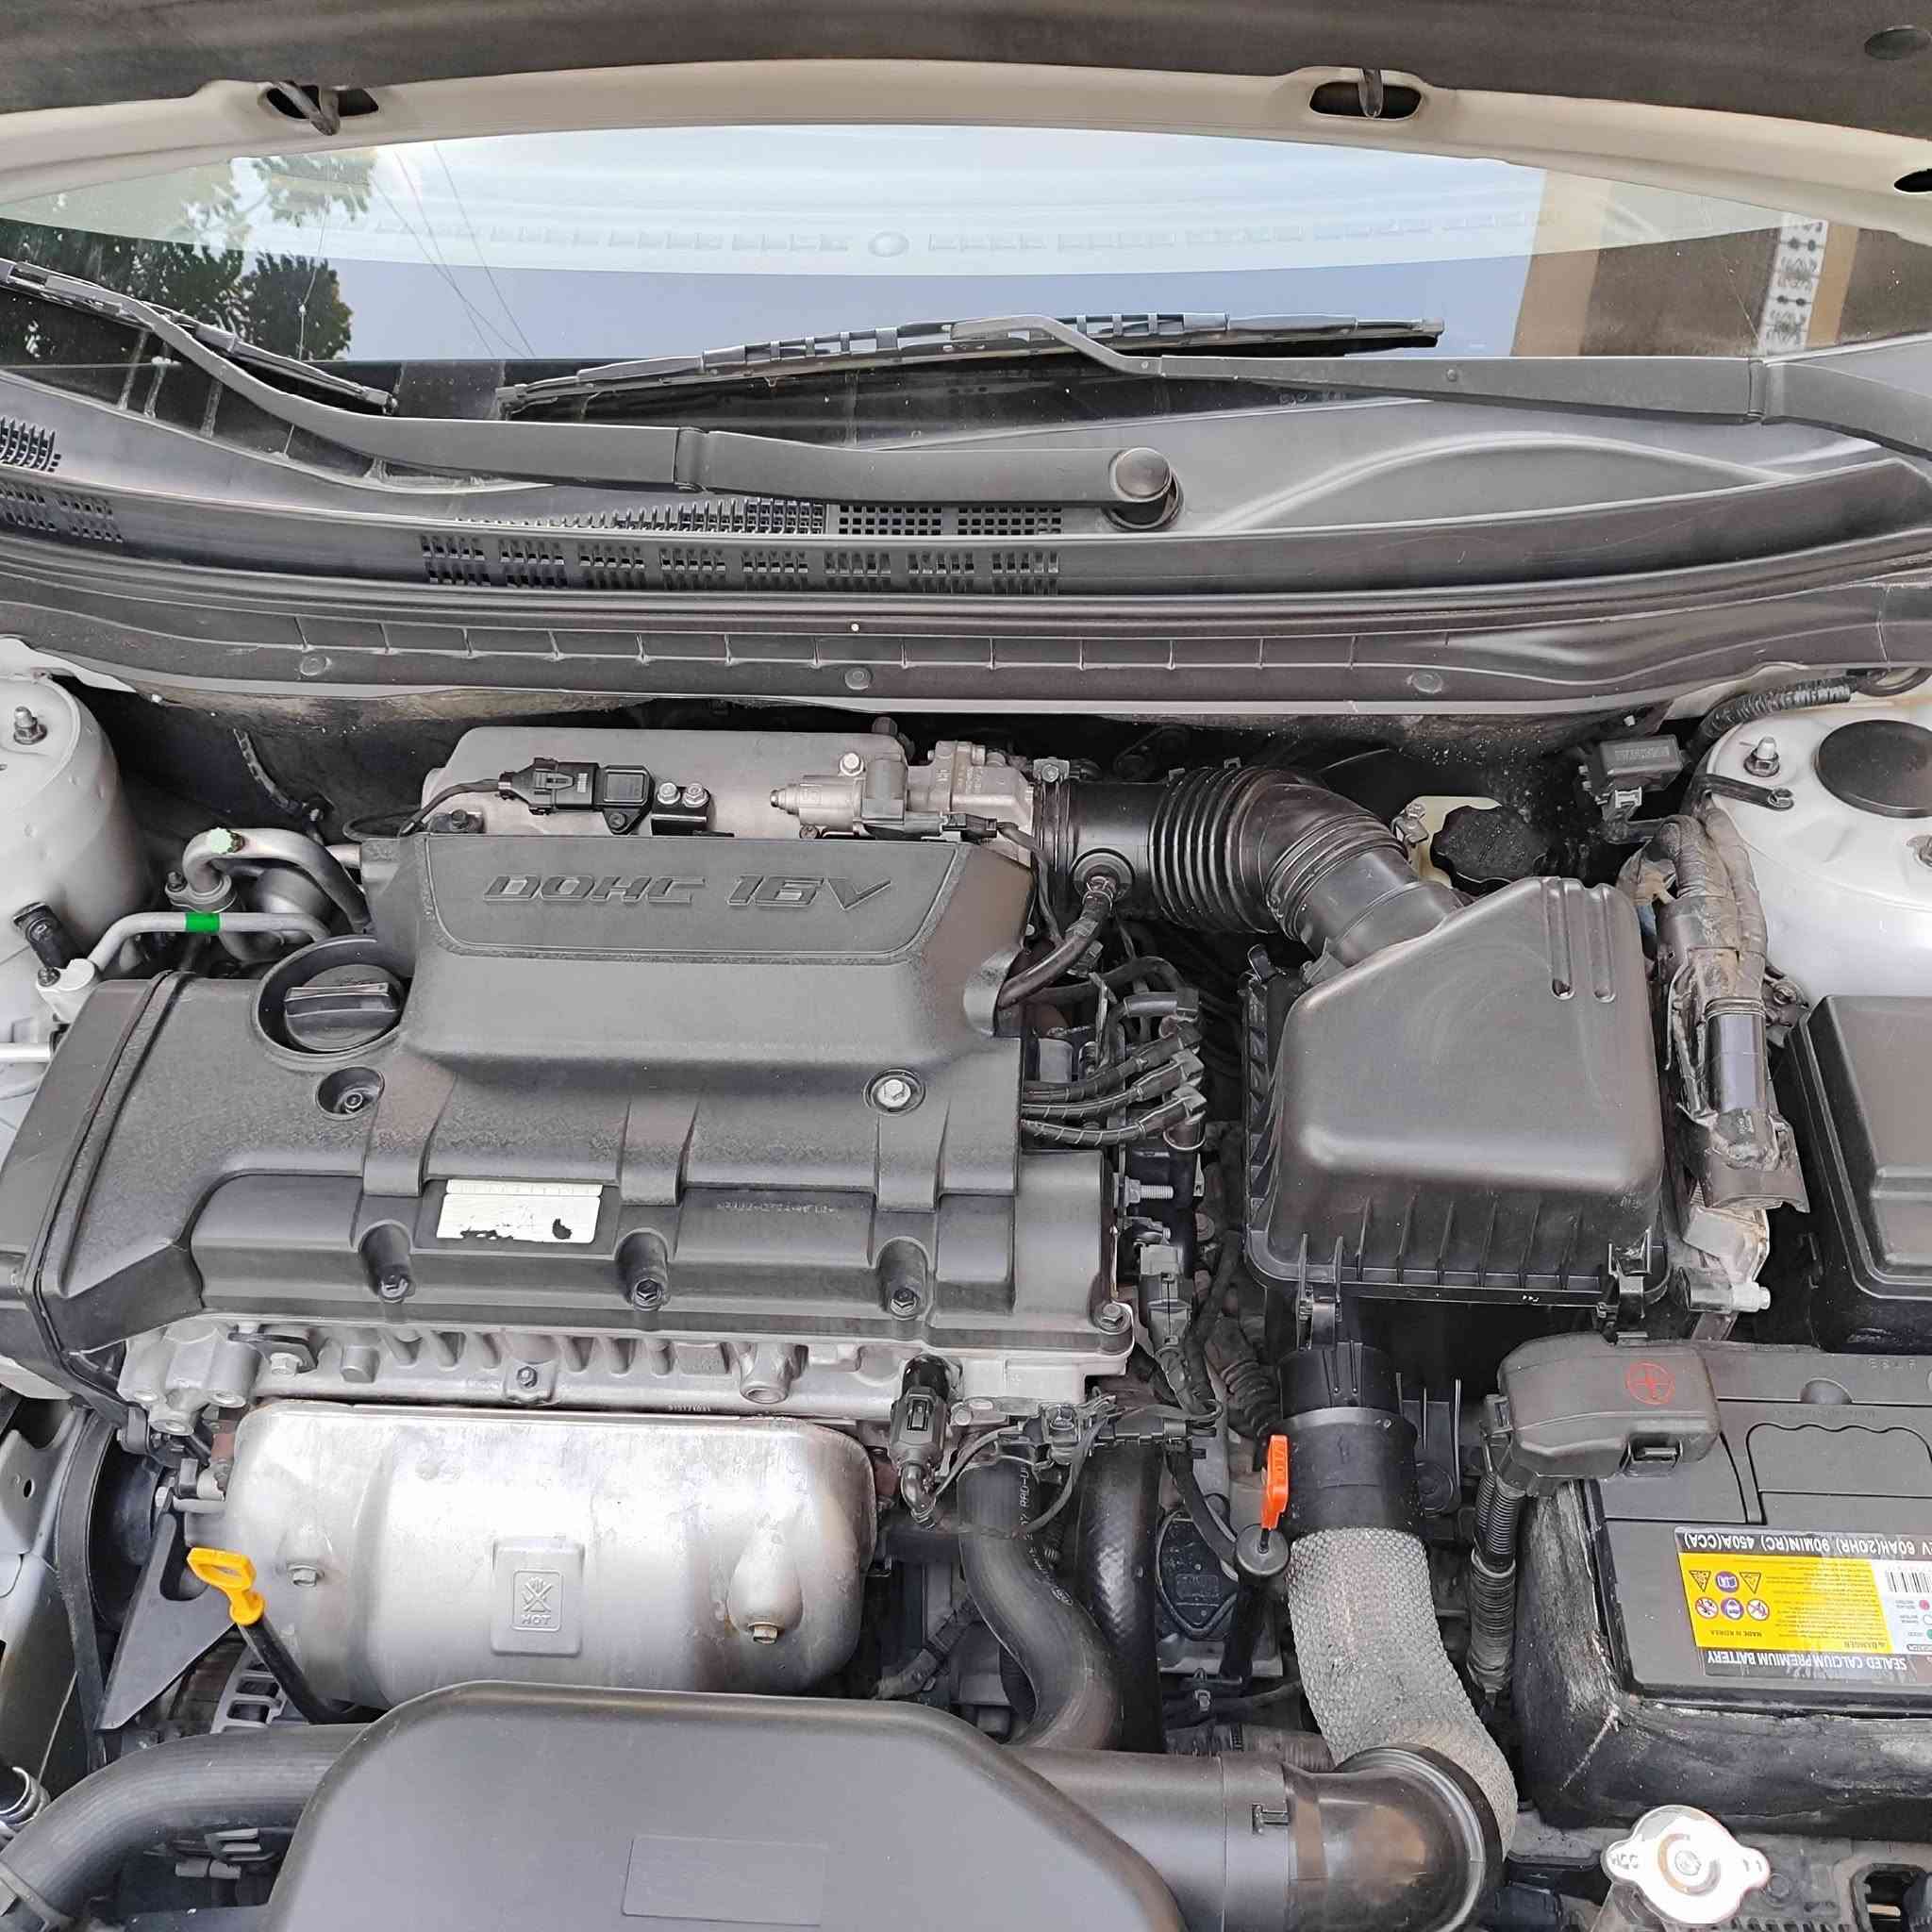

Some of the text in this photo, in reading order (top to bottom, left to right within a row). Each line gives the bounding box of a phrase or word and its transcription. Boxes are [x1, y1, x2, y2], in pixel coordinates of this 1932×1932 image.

[483, 874, 892, 911] DOHC 16V
[1685, 1534, 1755, 1550] 450A(CCA)
[1760, 1534, 1830, 1553] 90MIN(RC)
[1836, 1535, 1916, 1556] 60AH(20HR)
[522, 1614, 552, 1625] HOT
[1707, 1650, 1907, 1670] SEALED CALCIUM PREMIUM BATTERY
